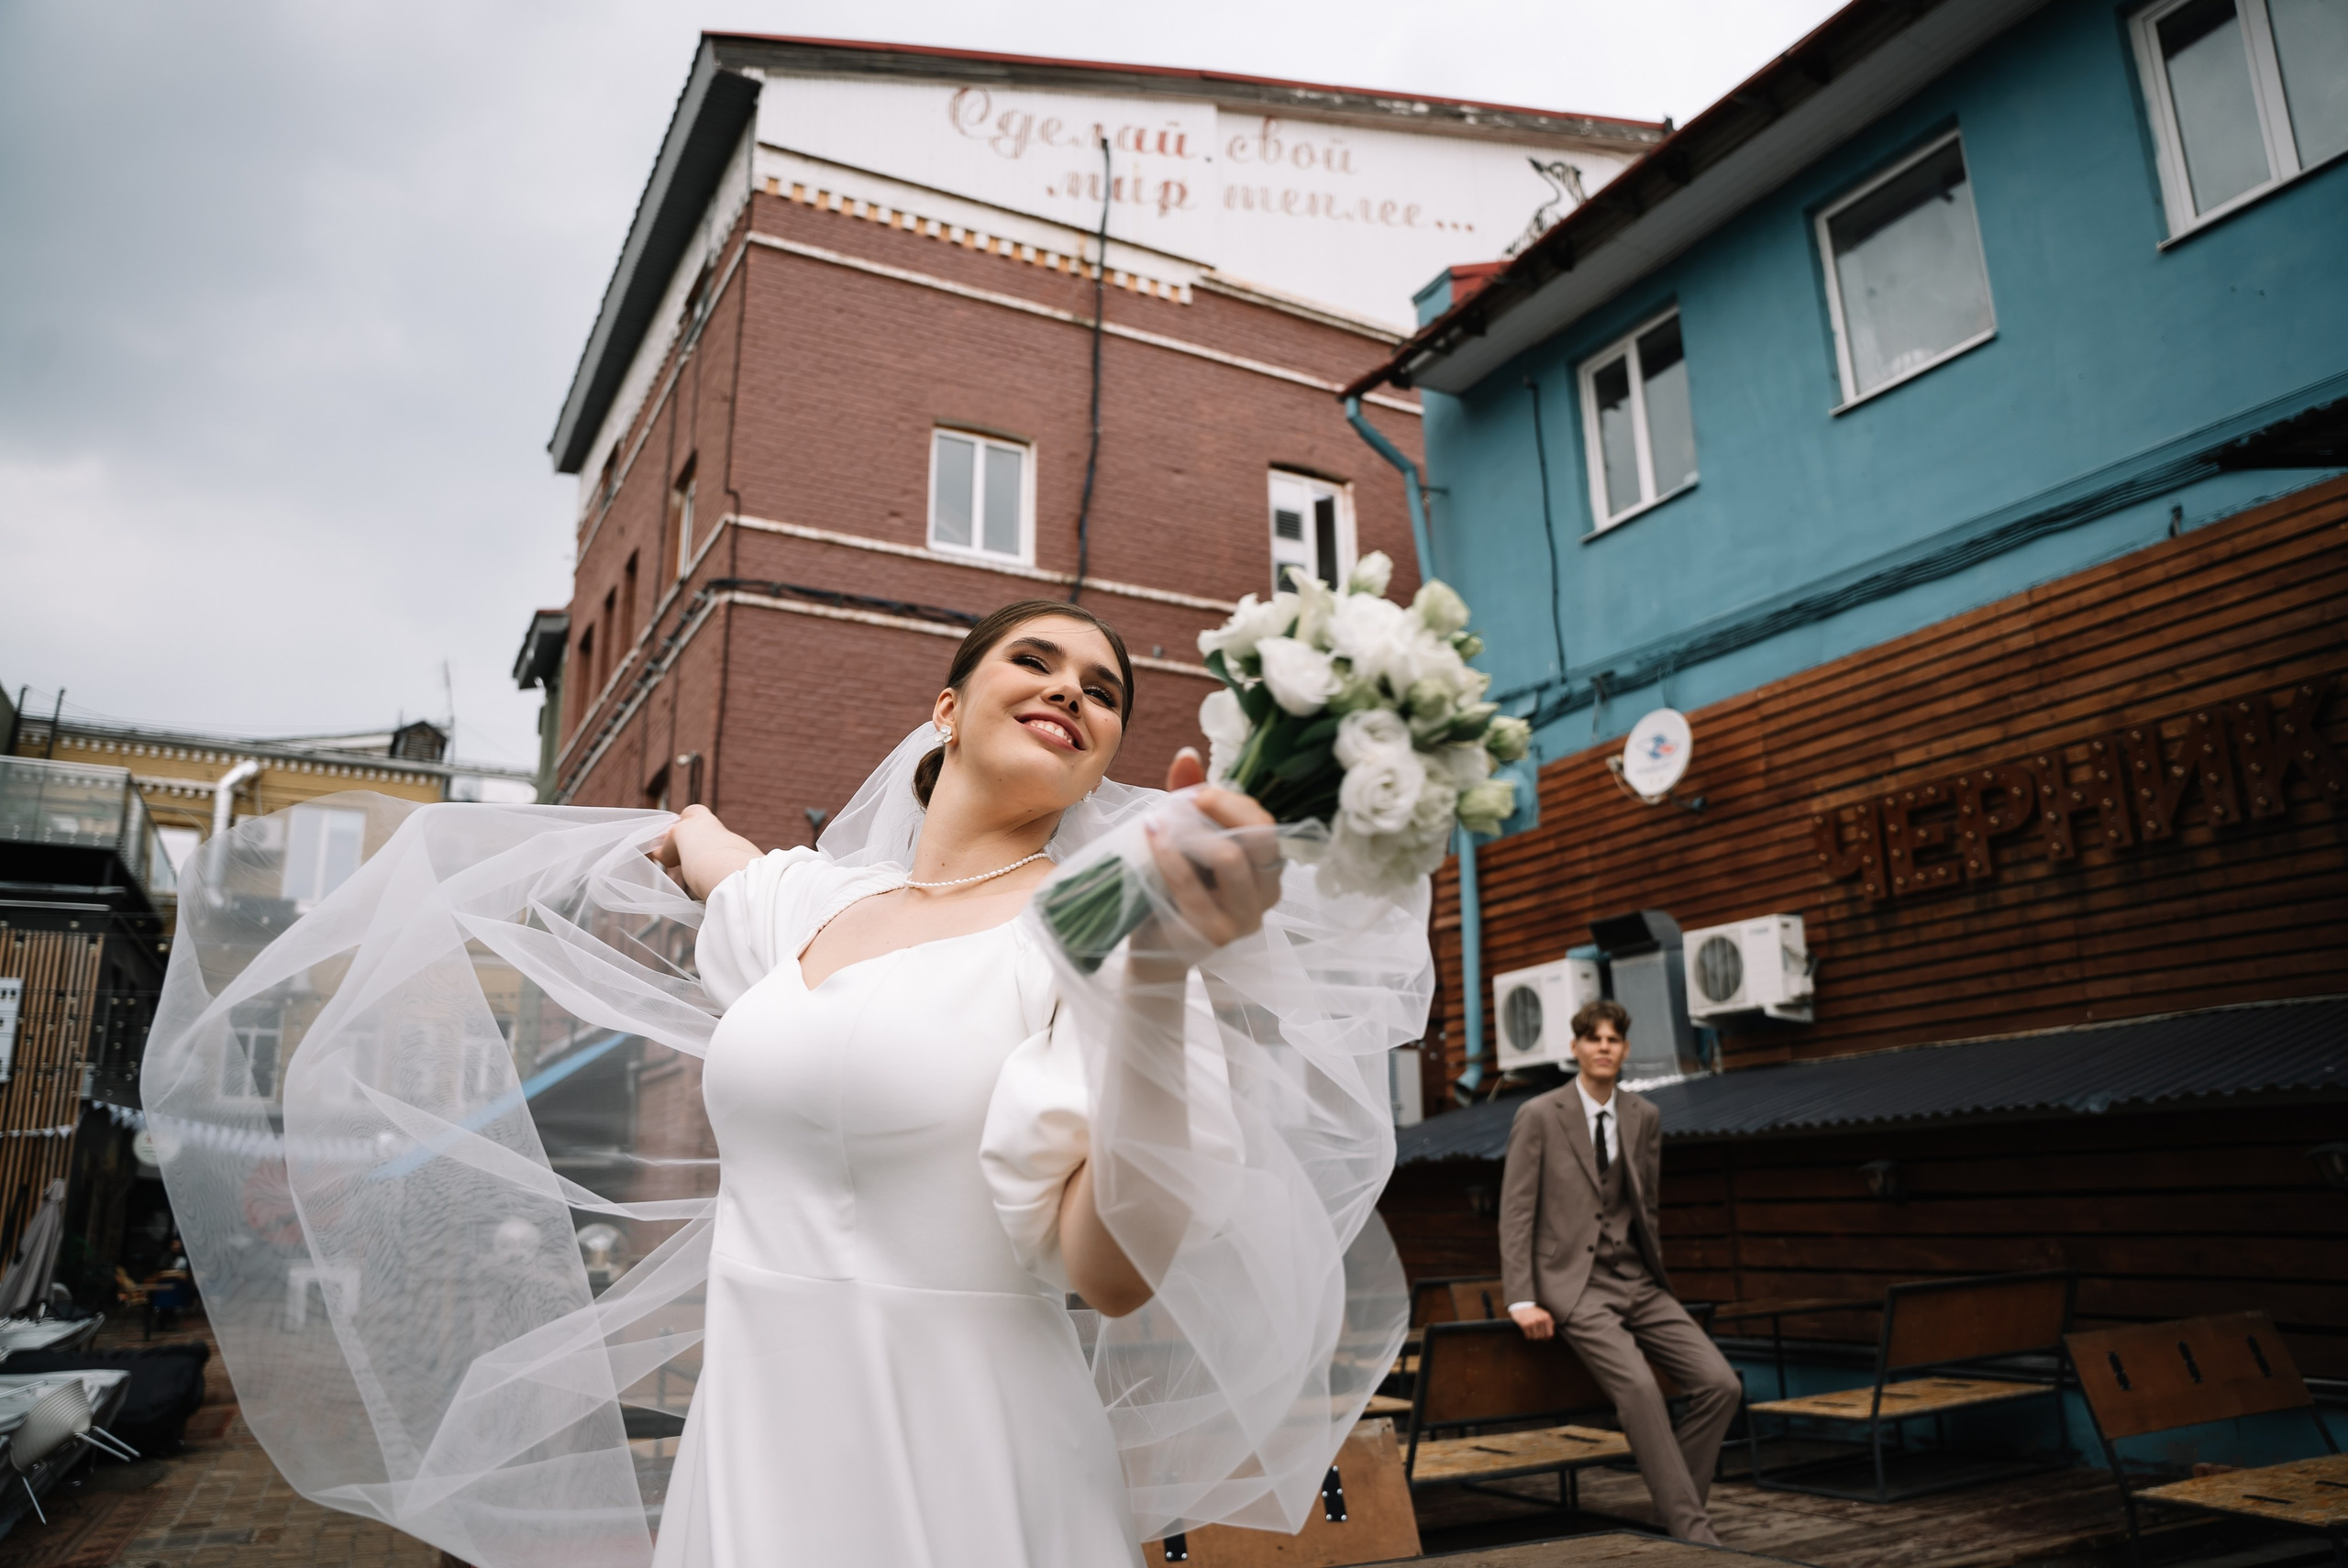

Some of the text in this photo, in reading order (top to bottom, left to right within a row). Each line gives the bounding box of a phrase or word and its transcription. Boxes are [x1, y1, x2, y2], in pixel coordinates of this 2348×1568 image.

[949, 86, 1355, 175] Сделай свой
[1047, 171, 1197, 218] мир
[1813, 677, 2348, 900] ЧЕРНИК
